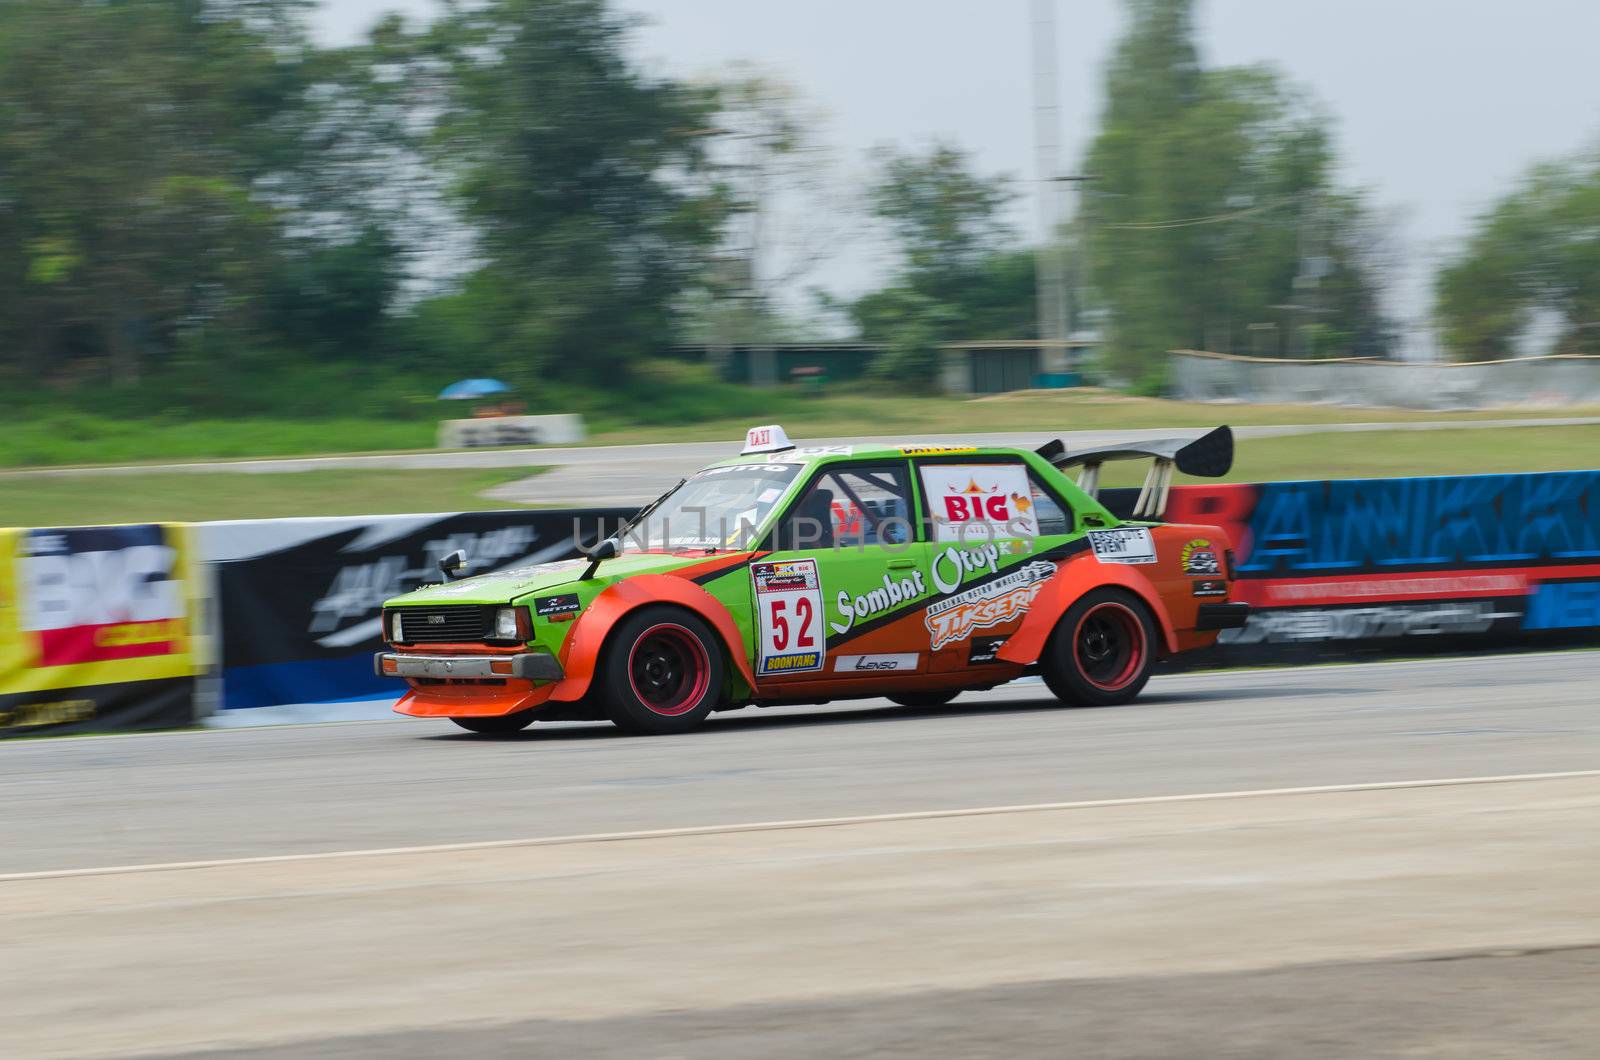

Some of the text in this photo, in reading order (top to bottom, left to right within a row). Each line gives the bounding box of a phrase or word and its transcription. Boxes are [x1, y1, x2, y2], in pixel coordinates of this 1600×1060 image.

[749, 430, 770, 446] TAXI
[943, 494, 1009, 522] BIG
[1094, 540, 1128, 553] EVENT
[830, 544, 999, 634] Sombat Otop
[771, 596, 814, 651] 52
[767, 654, 816, 670] BOONYANG
[855, 655, 899, 671] LENSO
